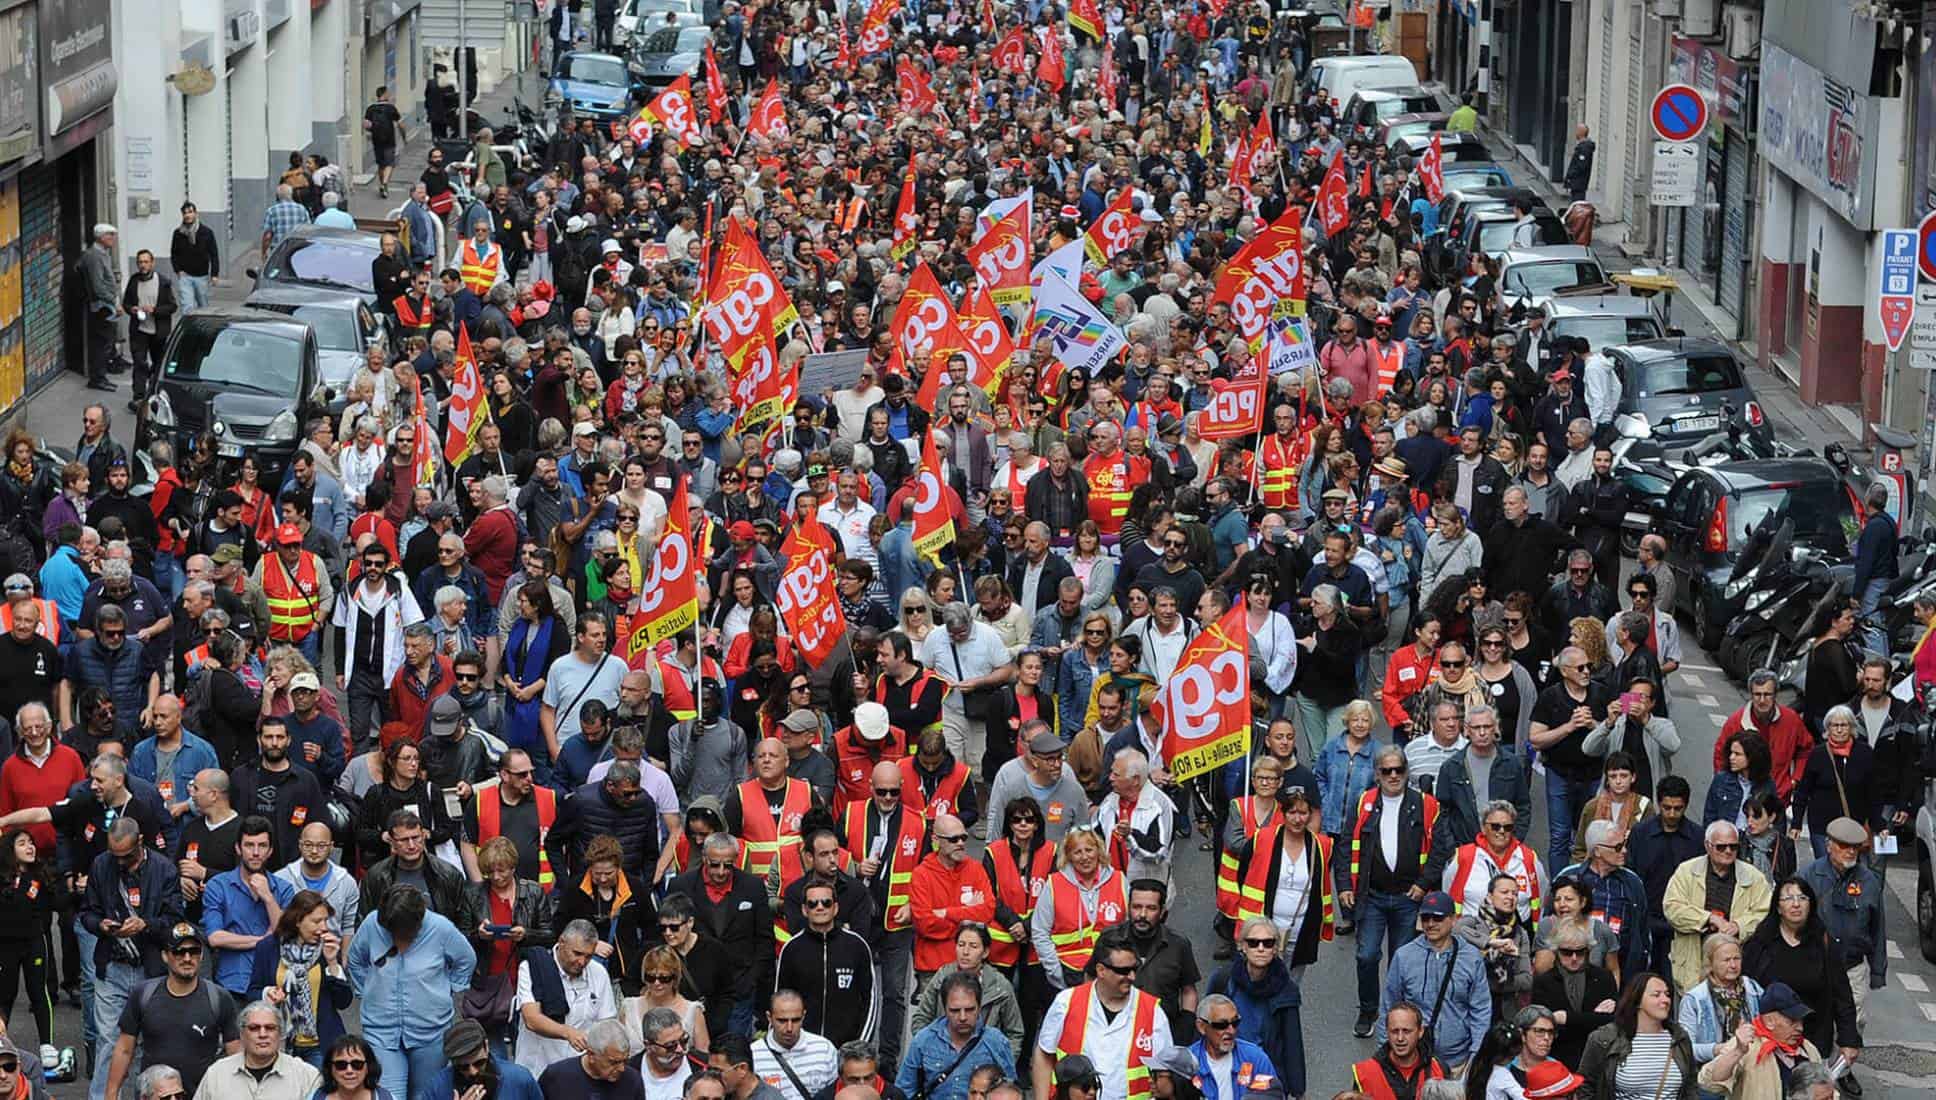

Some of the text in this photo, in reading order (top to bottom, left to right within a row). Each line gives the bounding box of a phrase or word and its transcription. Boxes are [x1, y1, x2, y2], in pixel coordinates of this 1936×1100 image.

[1894, 234, 1909, 255] P
[1887, 256, 1913, 264] PAYANT
[1915, 322, 1936, 331] DIREC
[1913, 334, 1936, 342] EMPLA
